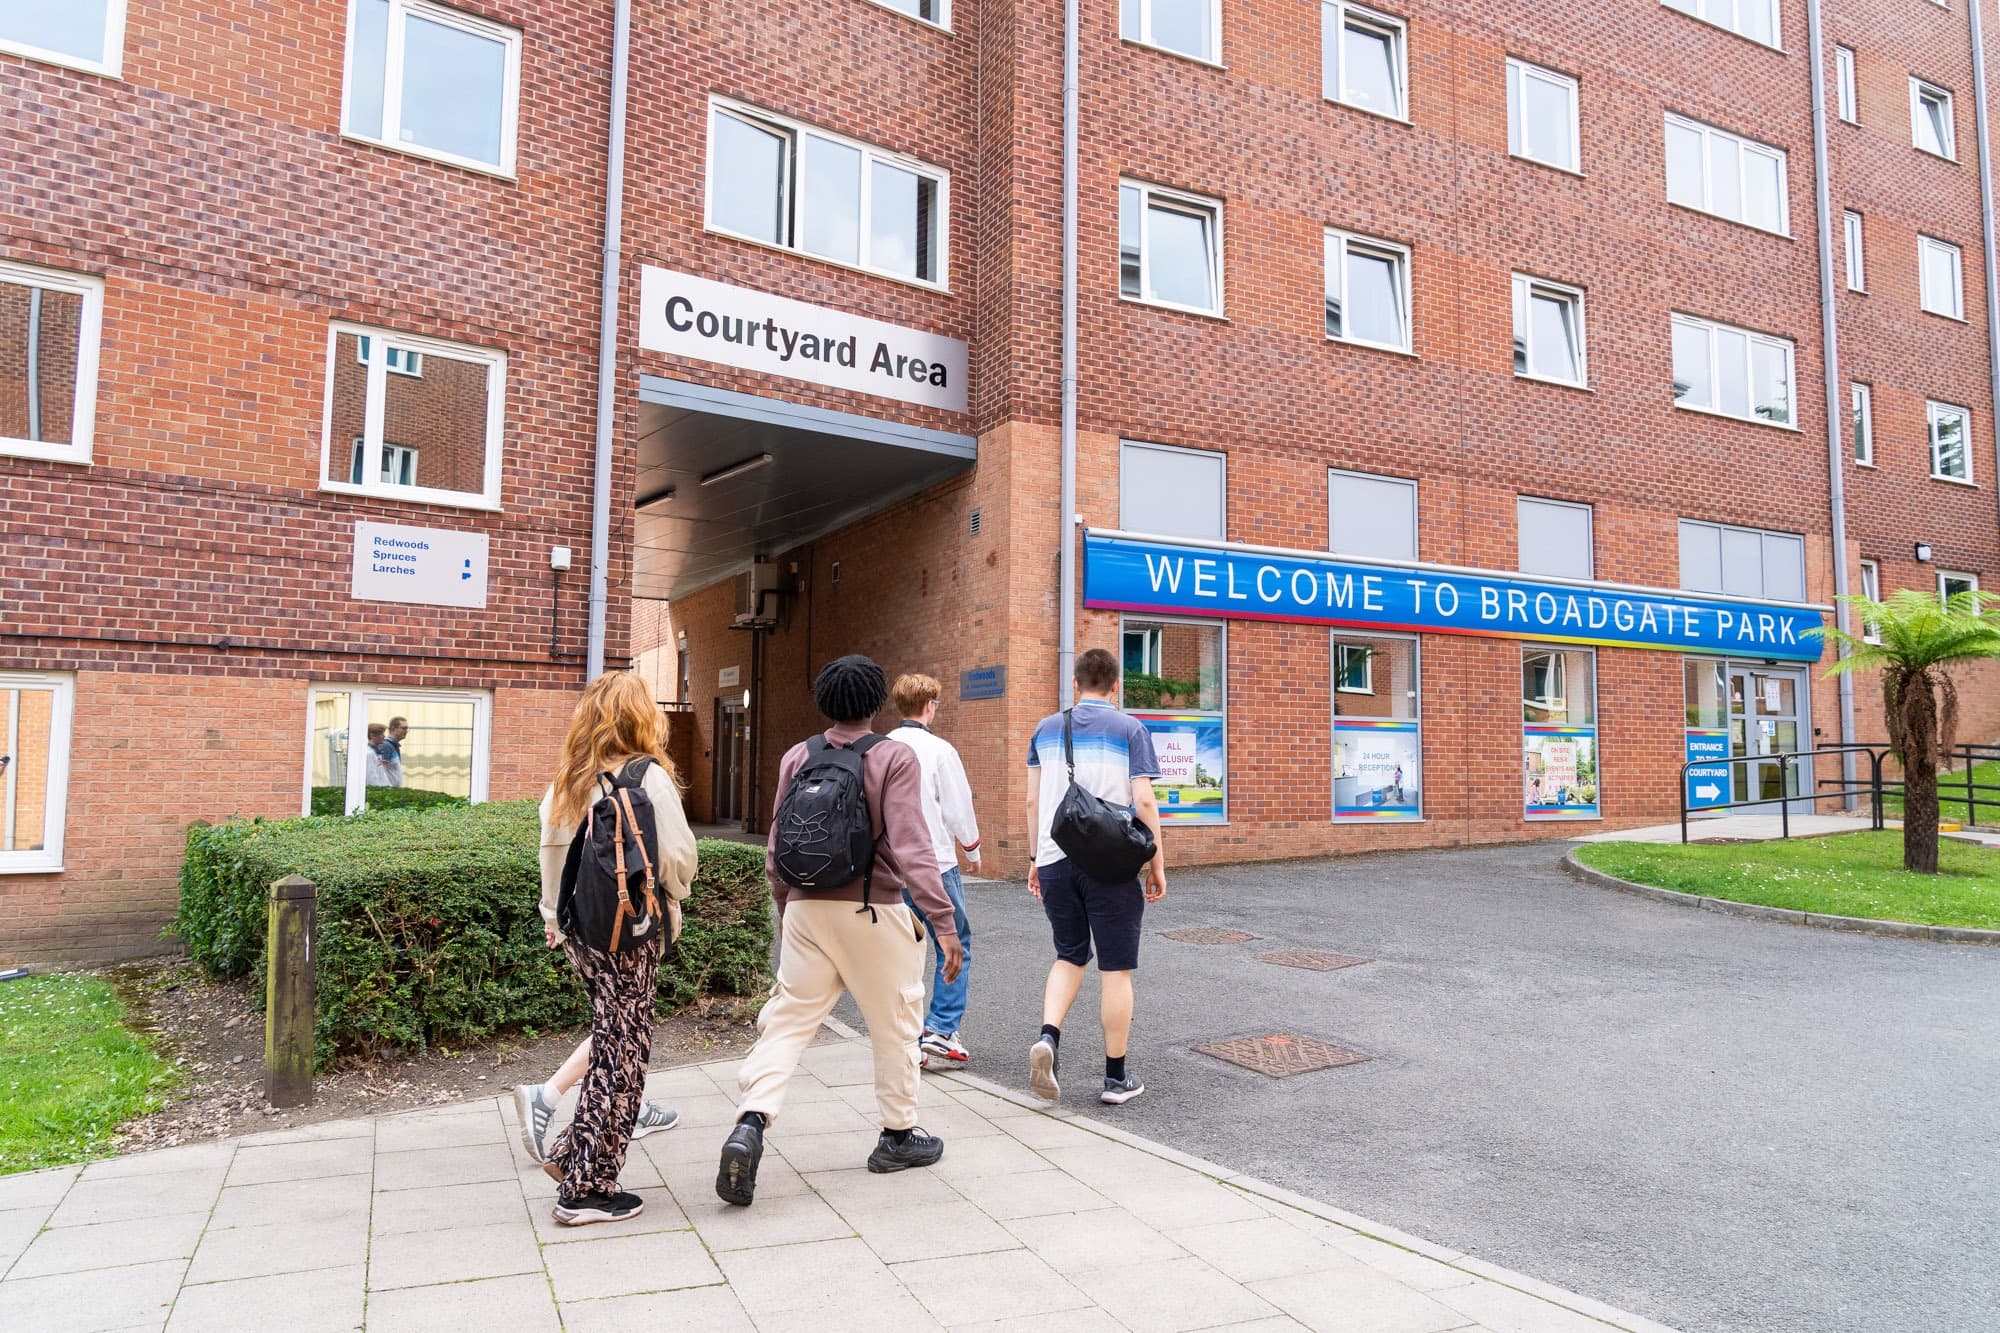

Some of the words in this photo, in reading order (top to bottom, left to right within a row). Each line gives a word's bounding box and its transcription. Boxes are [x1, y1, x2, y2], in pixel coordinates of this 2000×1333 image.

[664, 296, 857, 369] Courtyard
[869, 342, 947, 388] Area
[373, 536, 430, 550] Redwoods
[373, 550, 417, 562] Spruces
[372, 563, 416, 575] Larches
[1145, 553, 1384, 611] WELCOME
[1406, 579, 1458, 617] TO
[1481, 586, 1700, 638] BROADGATE
[1717, 609, 1796, 645] PARK
[1690, 742, 1724, 751] ENTRANCE
[1371, 752, 1390, 760] HOUR
[1161, 768, 1188, 776] RENTS
[1358, 763, 1395, 771] RECEPTION
[1688, 768, 1728, 777] COURTYARD
